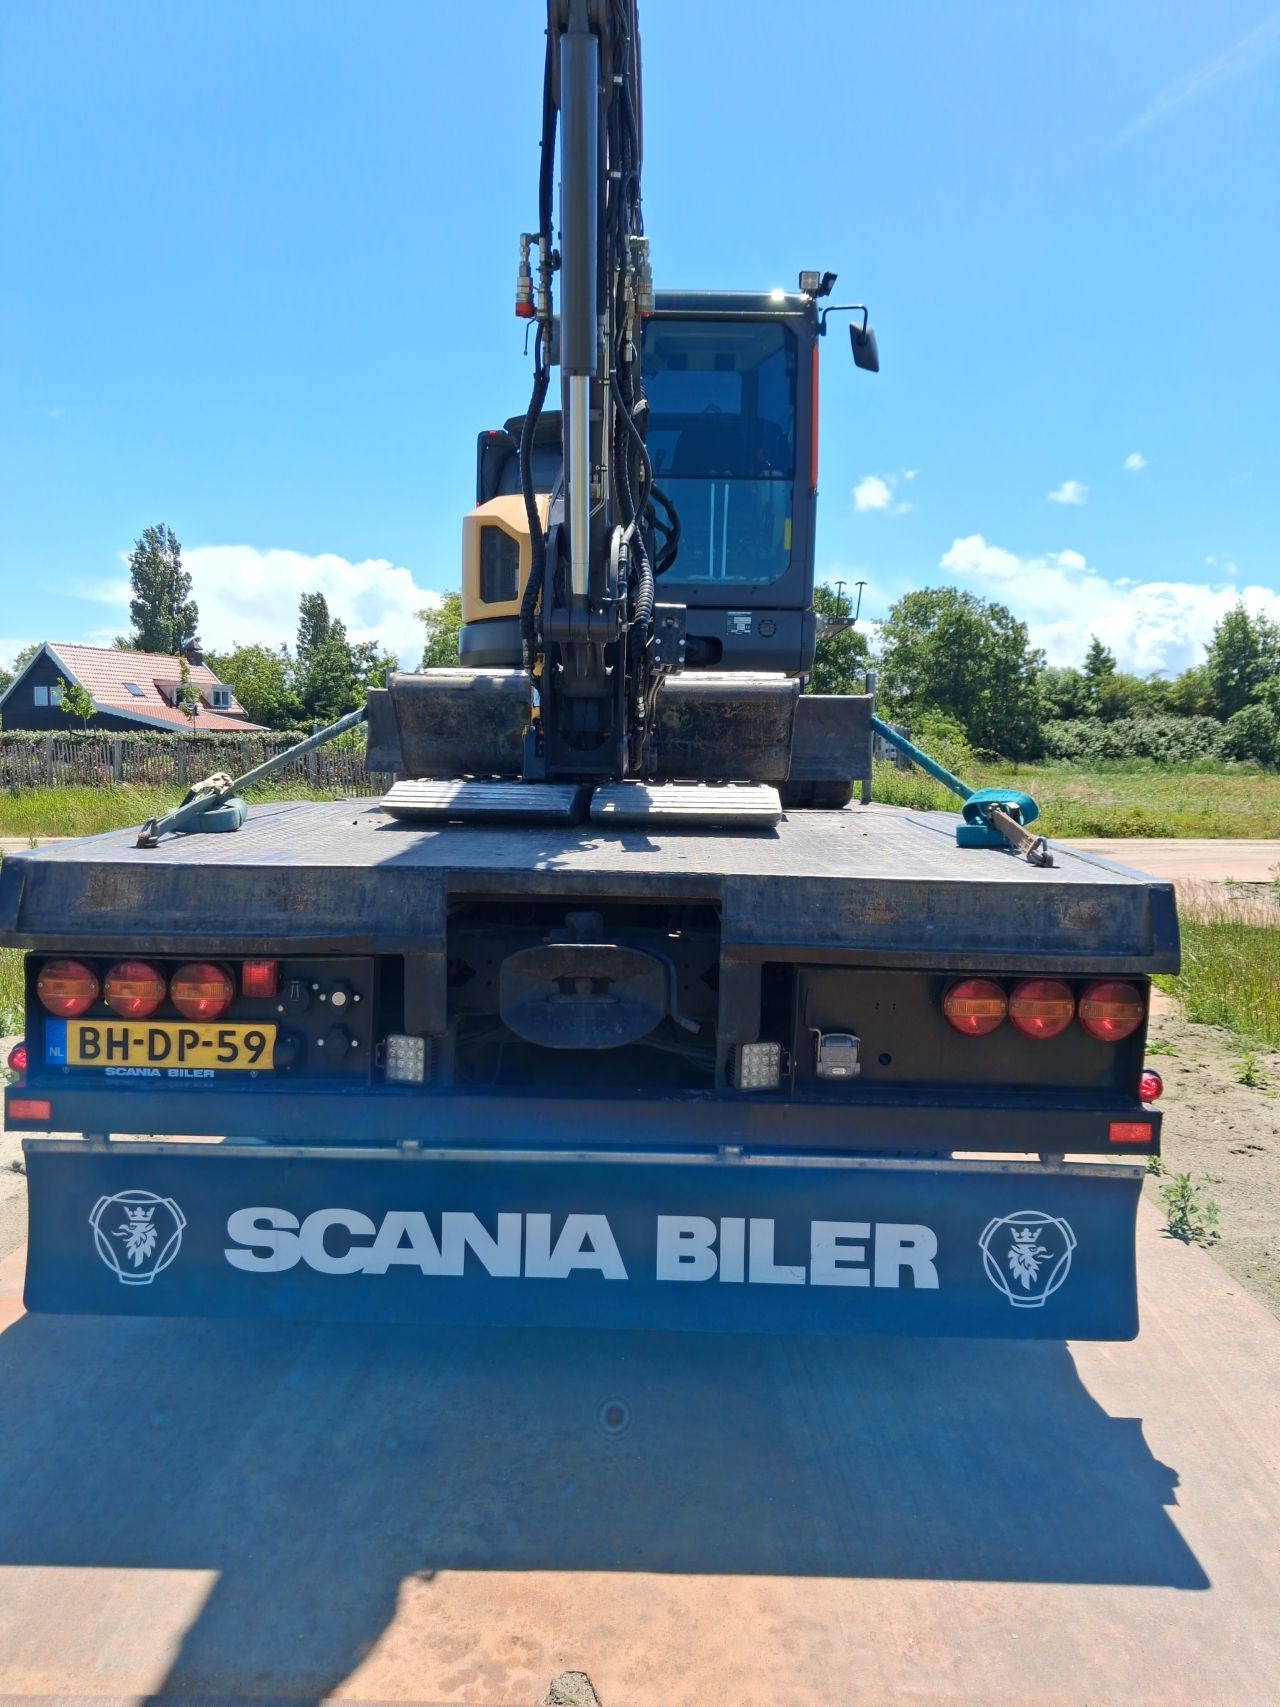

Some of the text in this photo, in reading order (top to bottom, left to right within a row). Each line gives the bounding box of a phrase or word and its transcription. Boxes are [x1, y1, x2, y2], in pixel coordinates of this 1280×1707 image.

[49, 1046, 64, 1057] NL
[79, 1026, 267, 1064] BH-DP-59
[105, 1067, 215, 1078] SCANIA BILER
[224, 1206, 940, 1289] SCANIA BILER
